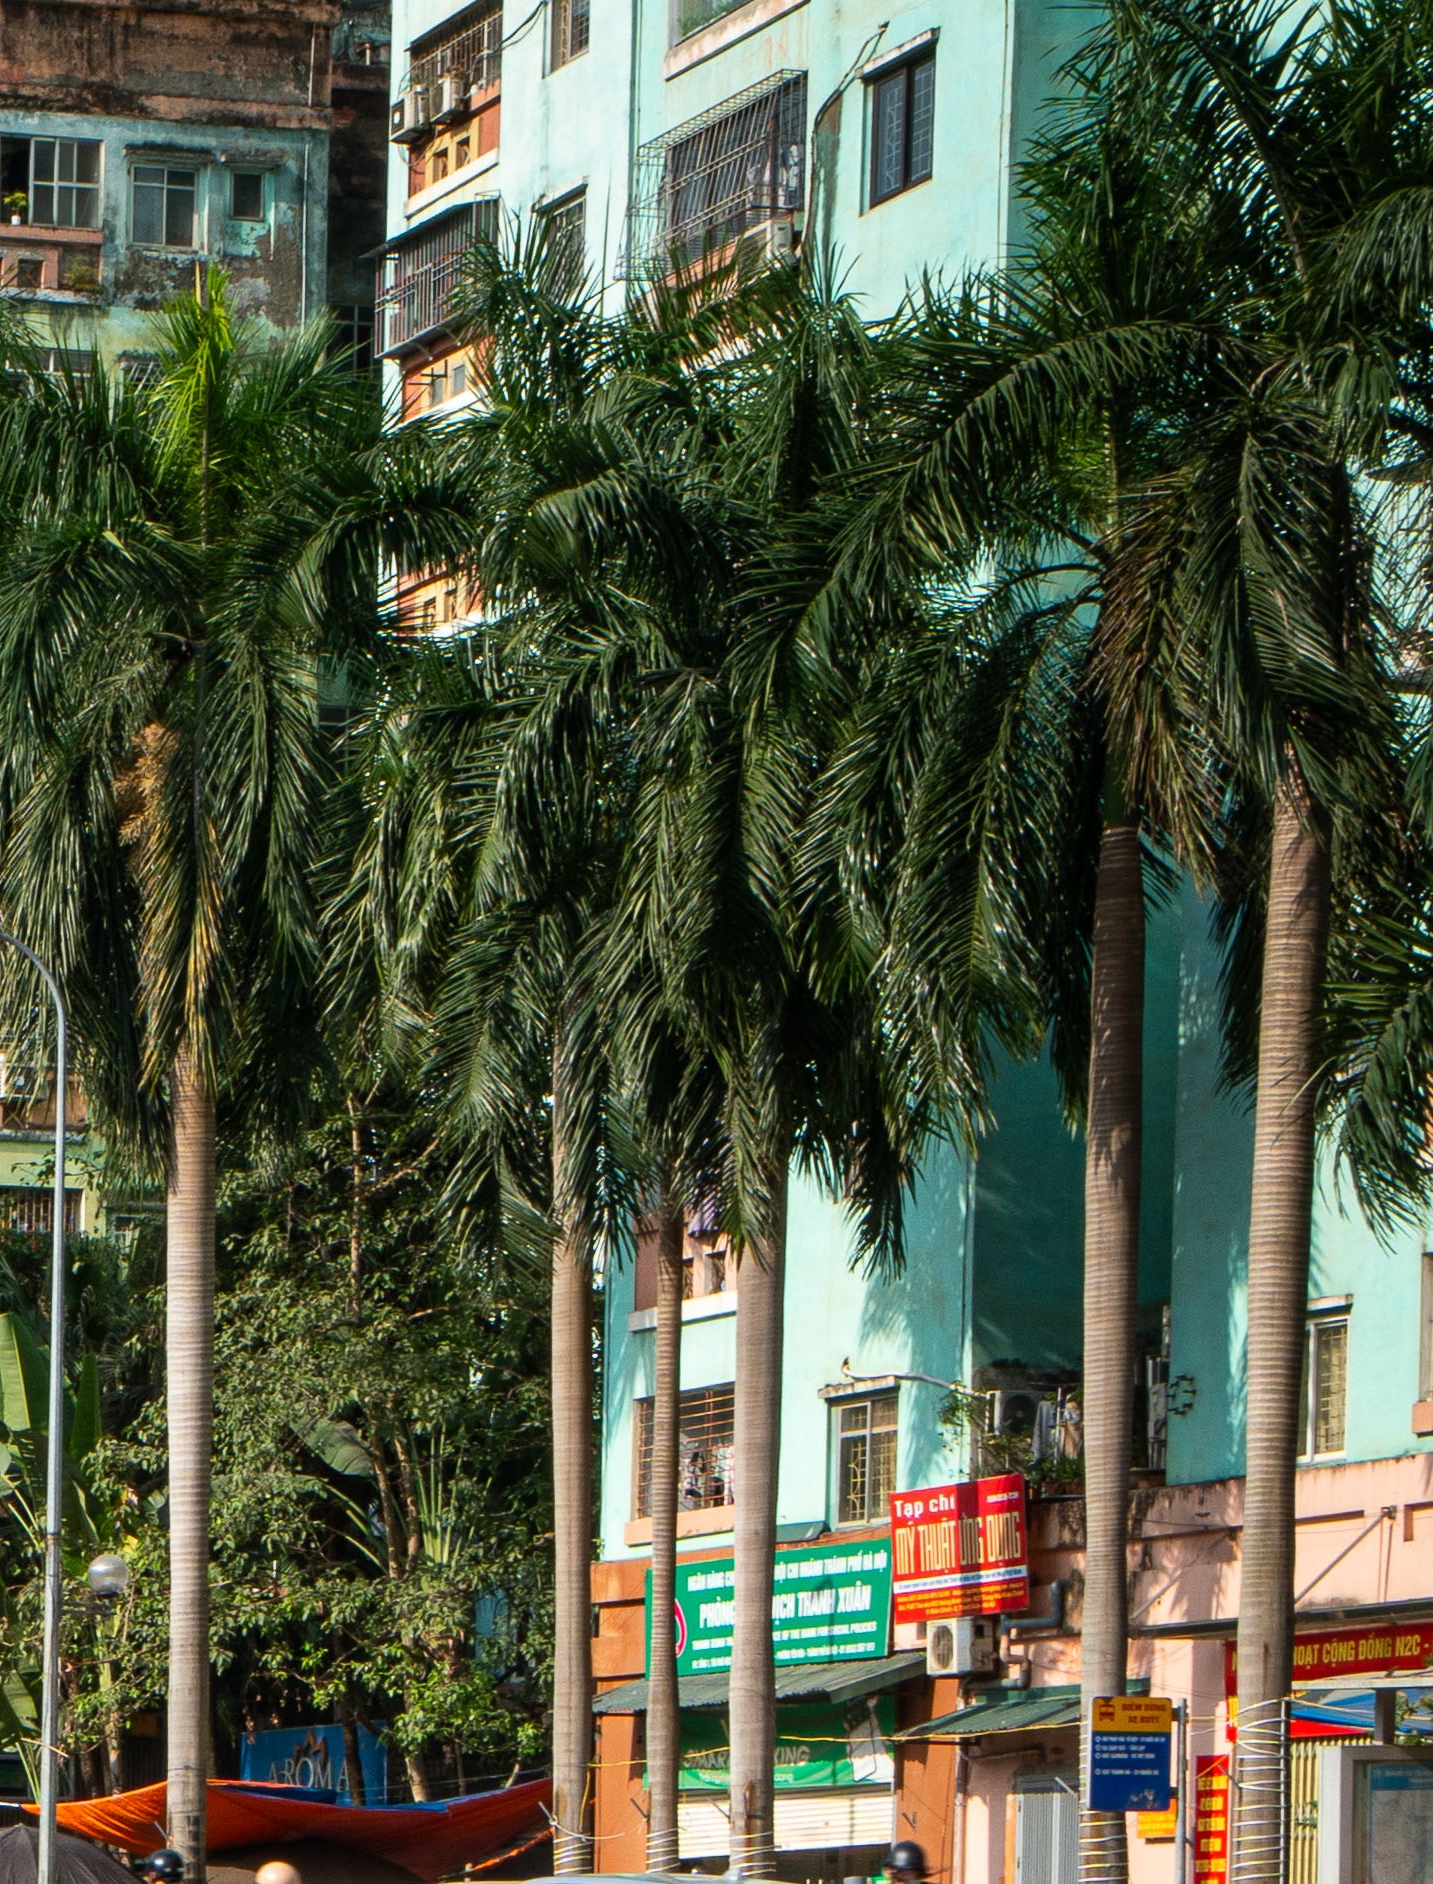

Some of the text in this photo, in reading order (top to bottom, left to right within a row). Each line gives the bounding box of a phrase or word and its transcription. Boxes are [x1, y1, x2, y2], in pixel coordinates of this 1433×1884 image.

[894, 1494, 955, 1518] Tạp chí
[895, 1521, 915, 1575] MỸ
[917, 1518, 956, 1573] THUẬT
[986, 1511, 1021, 1566] DỤNG
[797, 1588, 836, 1617] THANH
[837, 1580, 872, 1613] XUÂN
[1322, 1638, 1355, 1667] CỘNG
[1358, 1632, 1392, 1660] ĐỒNG
[1395, 1634, 1421, 1657] N2C
[269, 1757, 351, 1792] AROMA
[683, 1746, 811, 1771] SMAR KING
